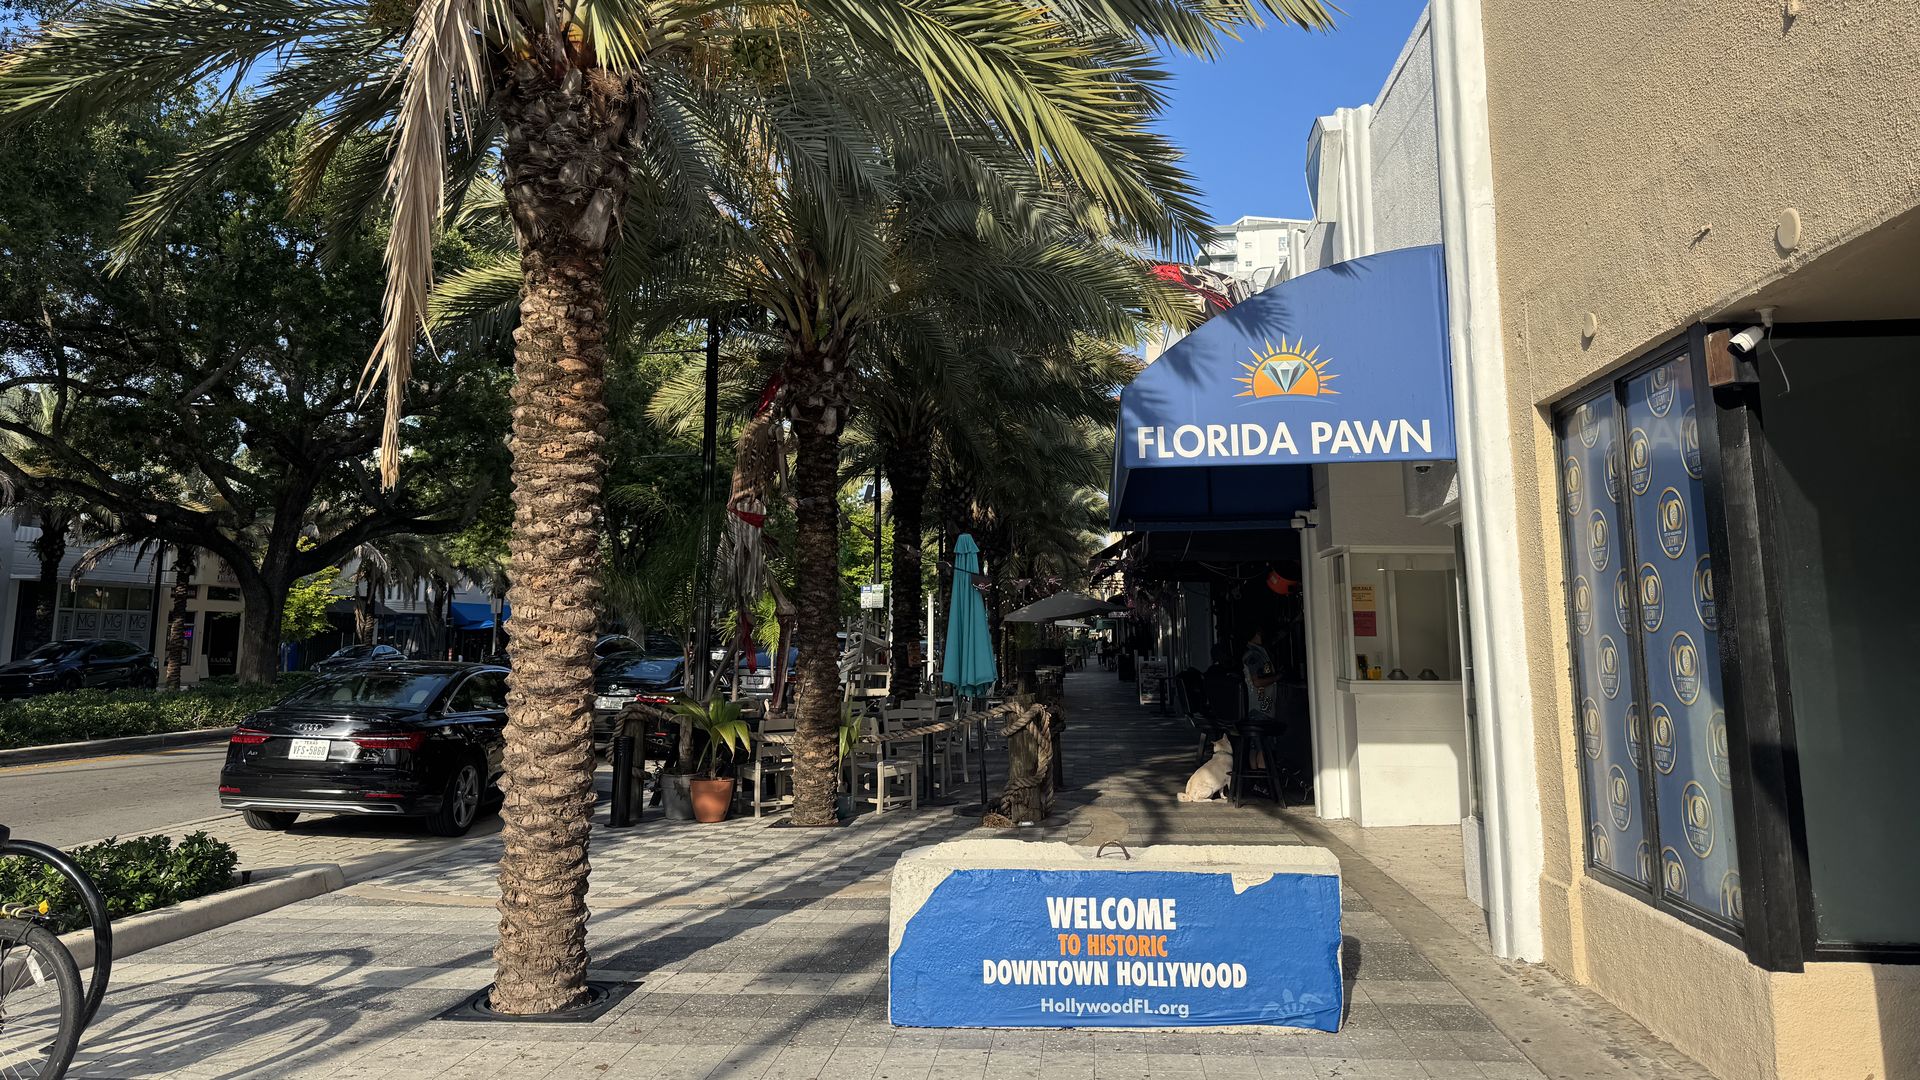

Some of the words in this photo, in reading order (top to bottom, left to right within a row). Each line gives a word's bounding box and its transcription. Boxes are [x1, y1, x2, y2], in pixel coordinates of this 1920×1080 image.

[1137, 422, 1299, 459] FLORIDA
[1311, 419, 1433, 455] PAWN
[1684, 420, 1699, 452] 10
[1660, 499, 1683, 532] 100
[1590, 520, 1606, 548] 100
[77, 613, 96, 629] MG
[104, 613, 122, 629] MG
[129, 614, 147, 630] MG
[1600, 646, 1617, 674] 100
[1672, 645, 1696, 676] 100
[1652, 715, 1672, 746] 100
[1609, 775, 1627, 805] 100
[1685, 794, 1709, 829] 100
[1046, 897, 1177, 930] WELCOME
[1058, 933, 1081, 955] TO
[1087, 934, 1168, 957] HISTORIC
[983, 959, 1109, 986] DOWNTOWN
[1117, 961, 1248, 988] HOLLYWOOD
[1041, 998, 1190, 1018] HollywoodFL.org
